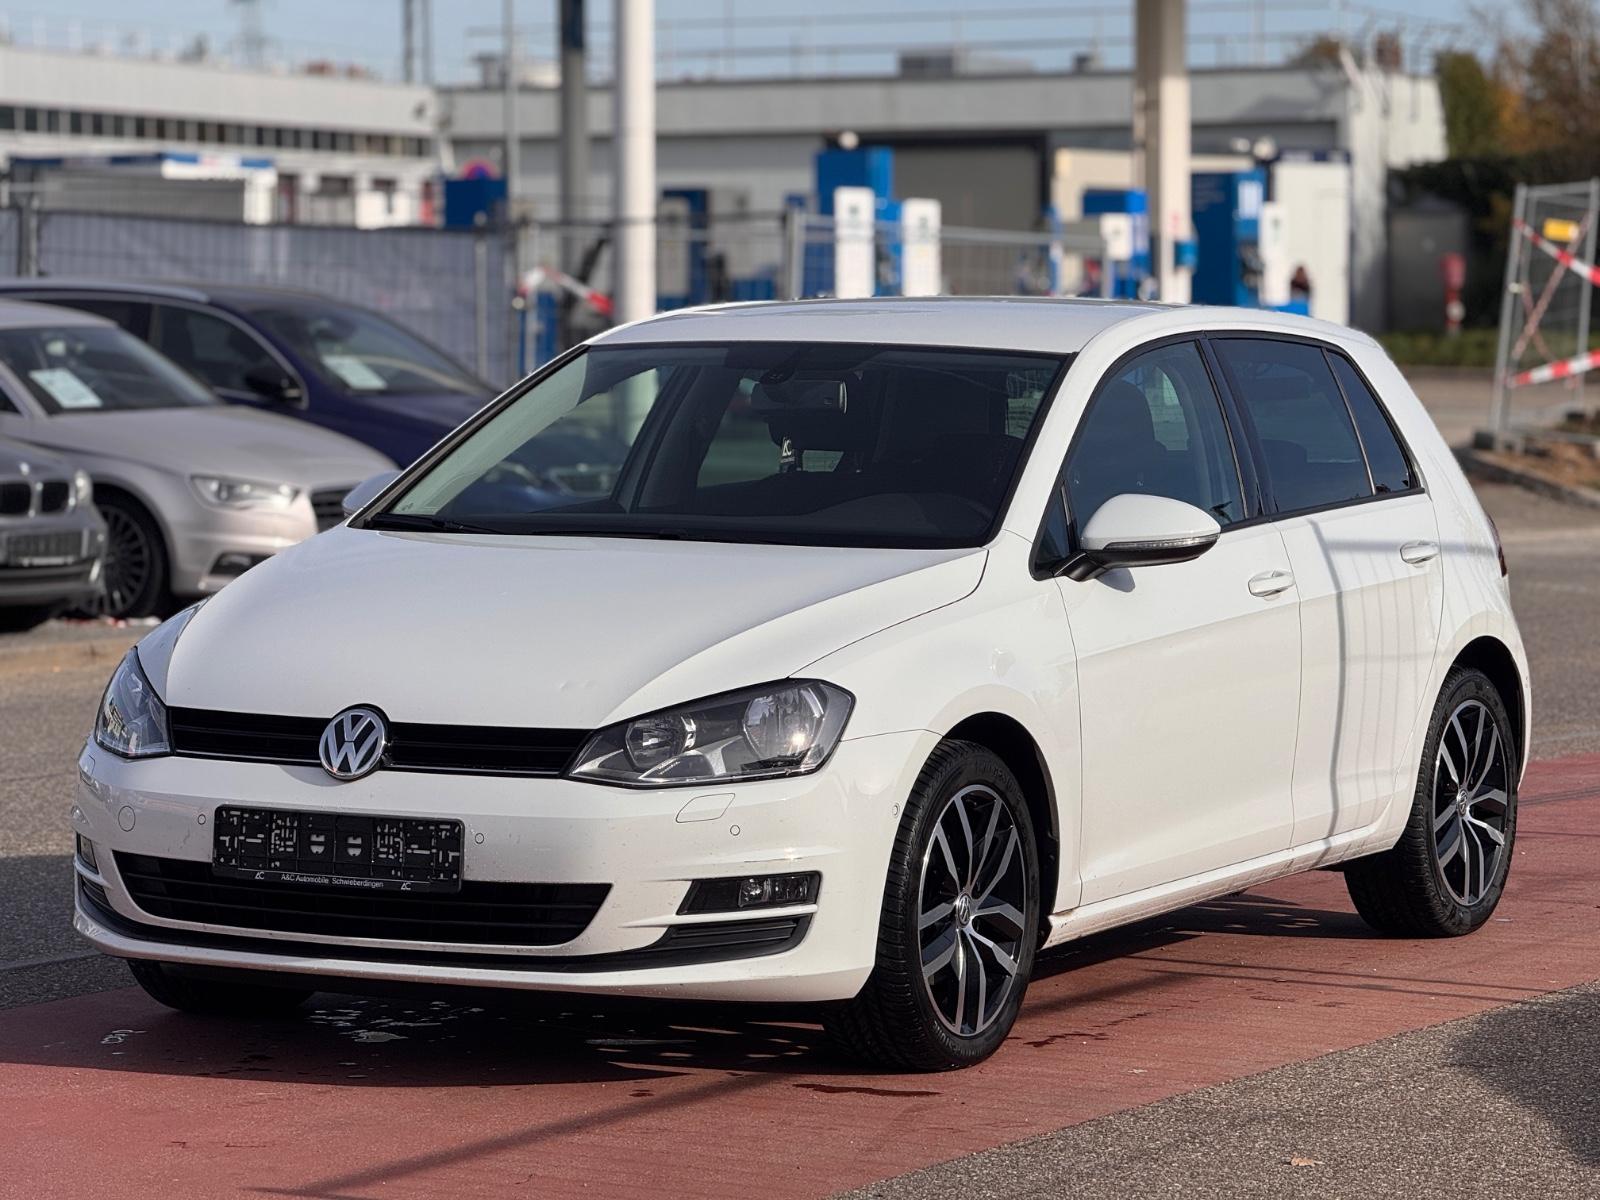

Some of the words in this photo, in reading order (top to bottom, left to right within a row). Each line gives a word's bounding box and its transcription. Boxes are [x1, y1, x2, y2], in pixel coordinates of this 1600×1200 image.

[320, 709, 385, 778] VW
[281, 873, 295, 881] A&C
[295, 874, 329, 884] Automobile
